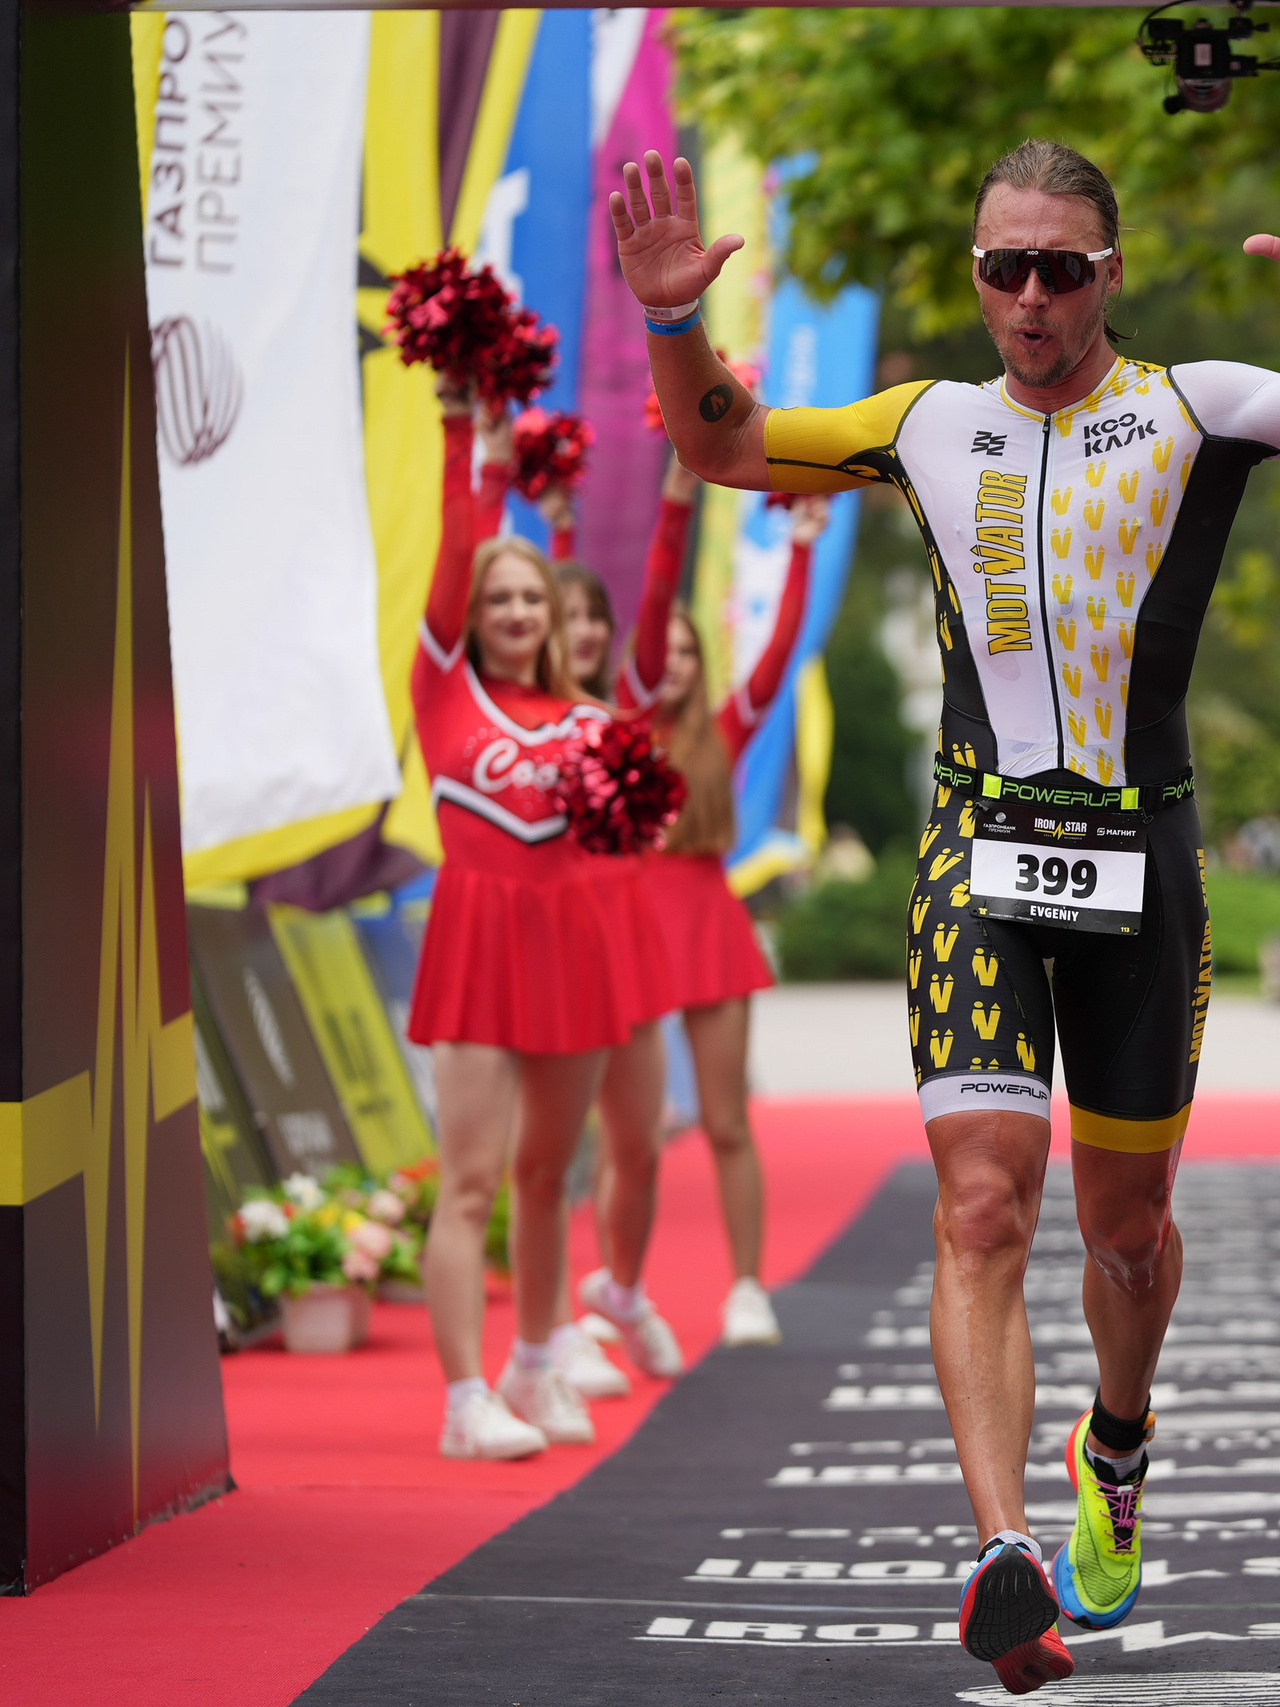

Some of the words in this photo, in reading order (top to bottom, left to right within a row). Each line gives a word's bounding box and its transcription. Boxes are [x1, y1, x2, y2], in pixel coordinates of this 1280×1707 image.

[1085, 418, 1158, 457] KASK
[473, 737, 560, 794] Coo
[1002, 782, 1121, 807] POWERUP
[1034, 818, 1055, 830] IRON
[1064, 821, 1087, 833] STAR
[1106, 829, 1137, 837] МАГНИТ
[1015, 853, 1098, 899] 399
[1030, 905, 1079, 922] EVGENIY
[960, 1083, 1048, 1100] POWERUP
